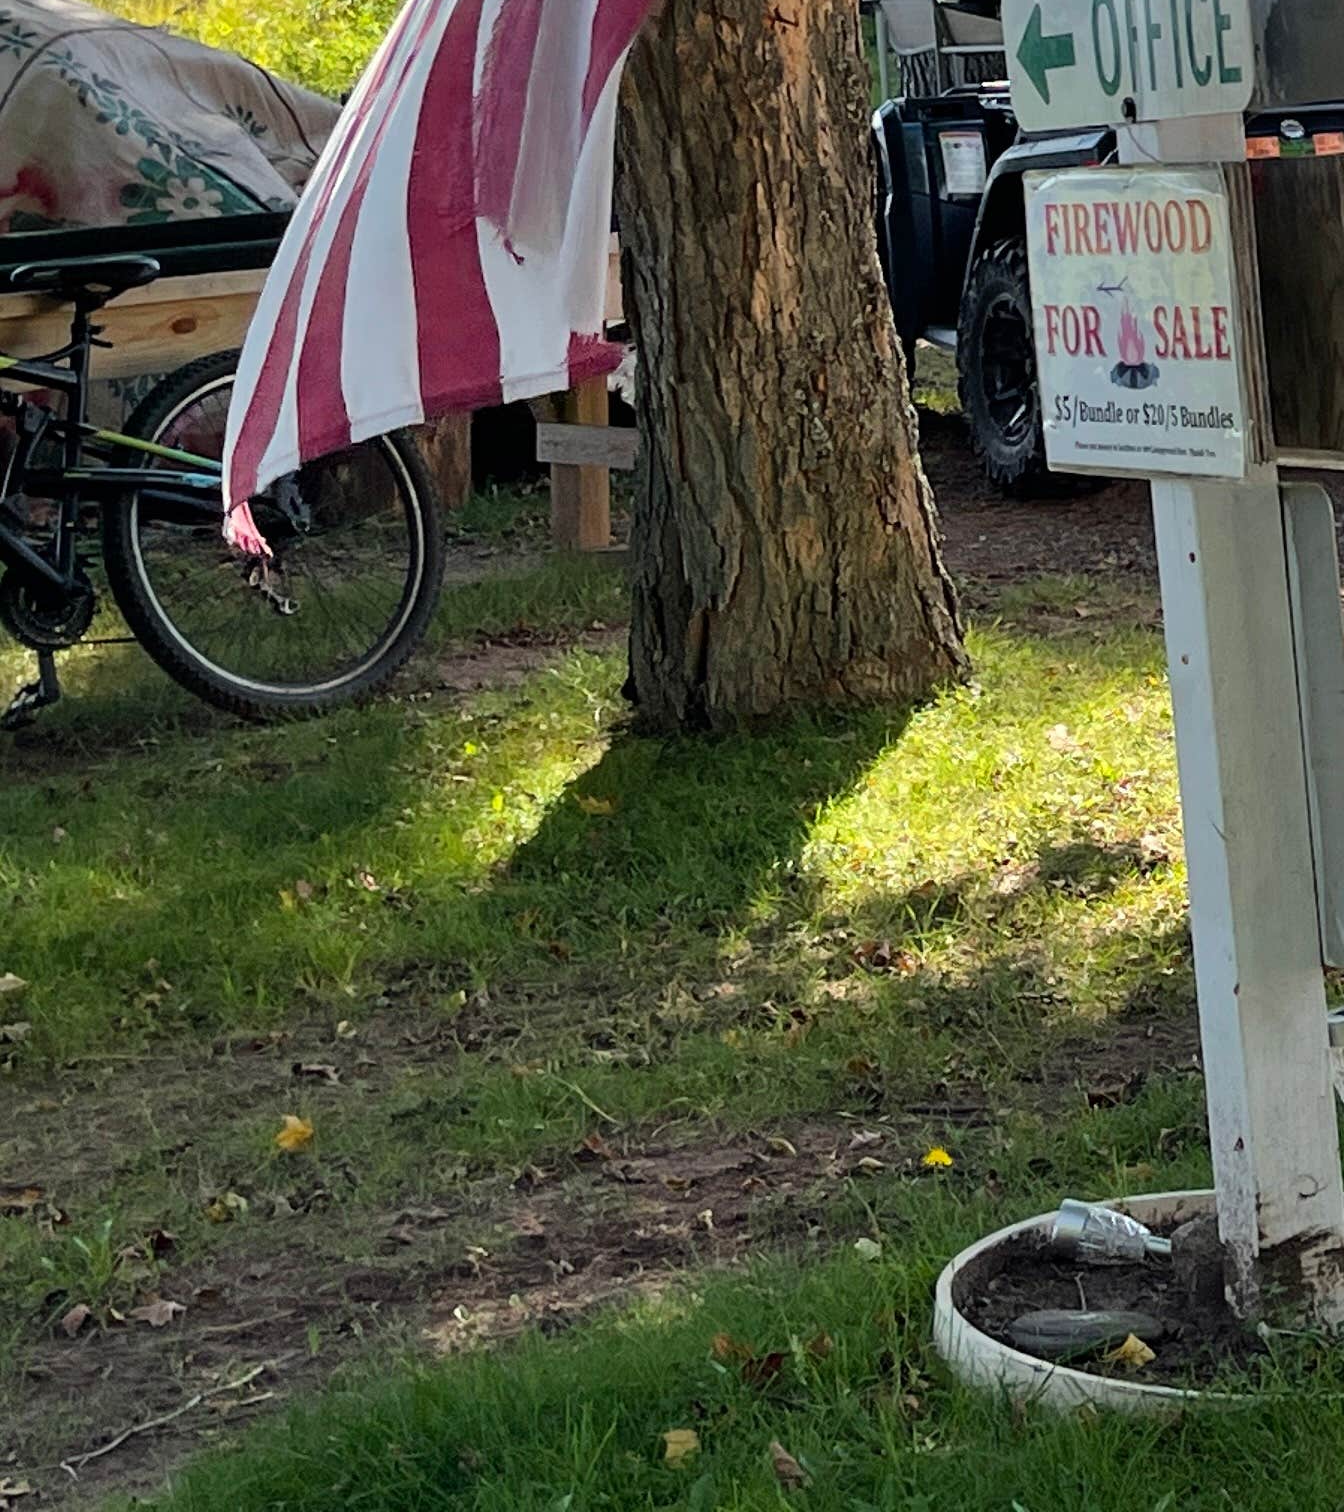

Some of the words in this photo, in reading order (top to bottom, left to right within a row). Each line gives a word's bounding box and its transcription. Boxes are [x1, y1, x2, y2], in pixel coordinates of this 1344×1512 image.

[1044, 199, 1213, 256] FIREWOOD
[1044, 304, 1107, 359] FOR
[1153, 305, 1231, 360] SALE
[1055, 394, 1123, 428] $5/Bundle
[1126, 406, 1140, 425] or
[1143, 402, 1178, 431] $20/5
[1181, 405, 1236, 430] Bundles
